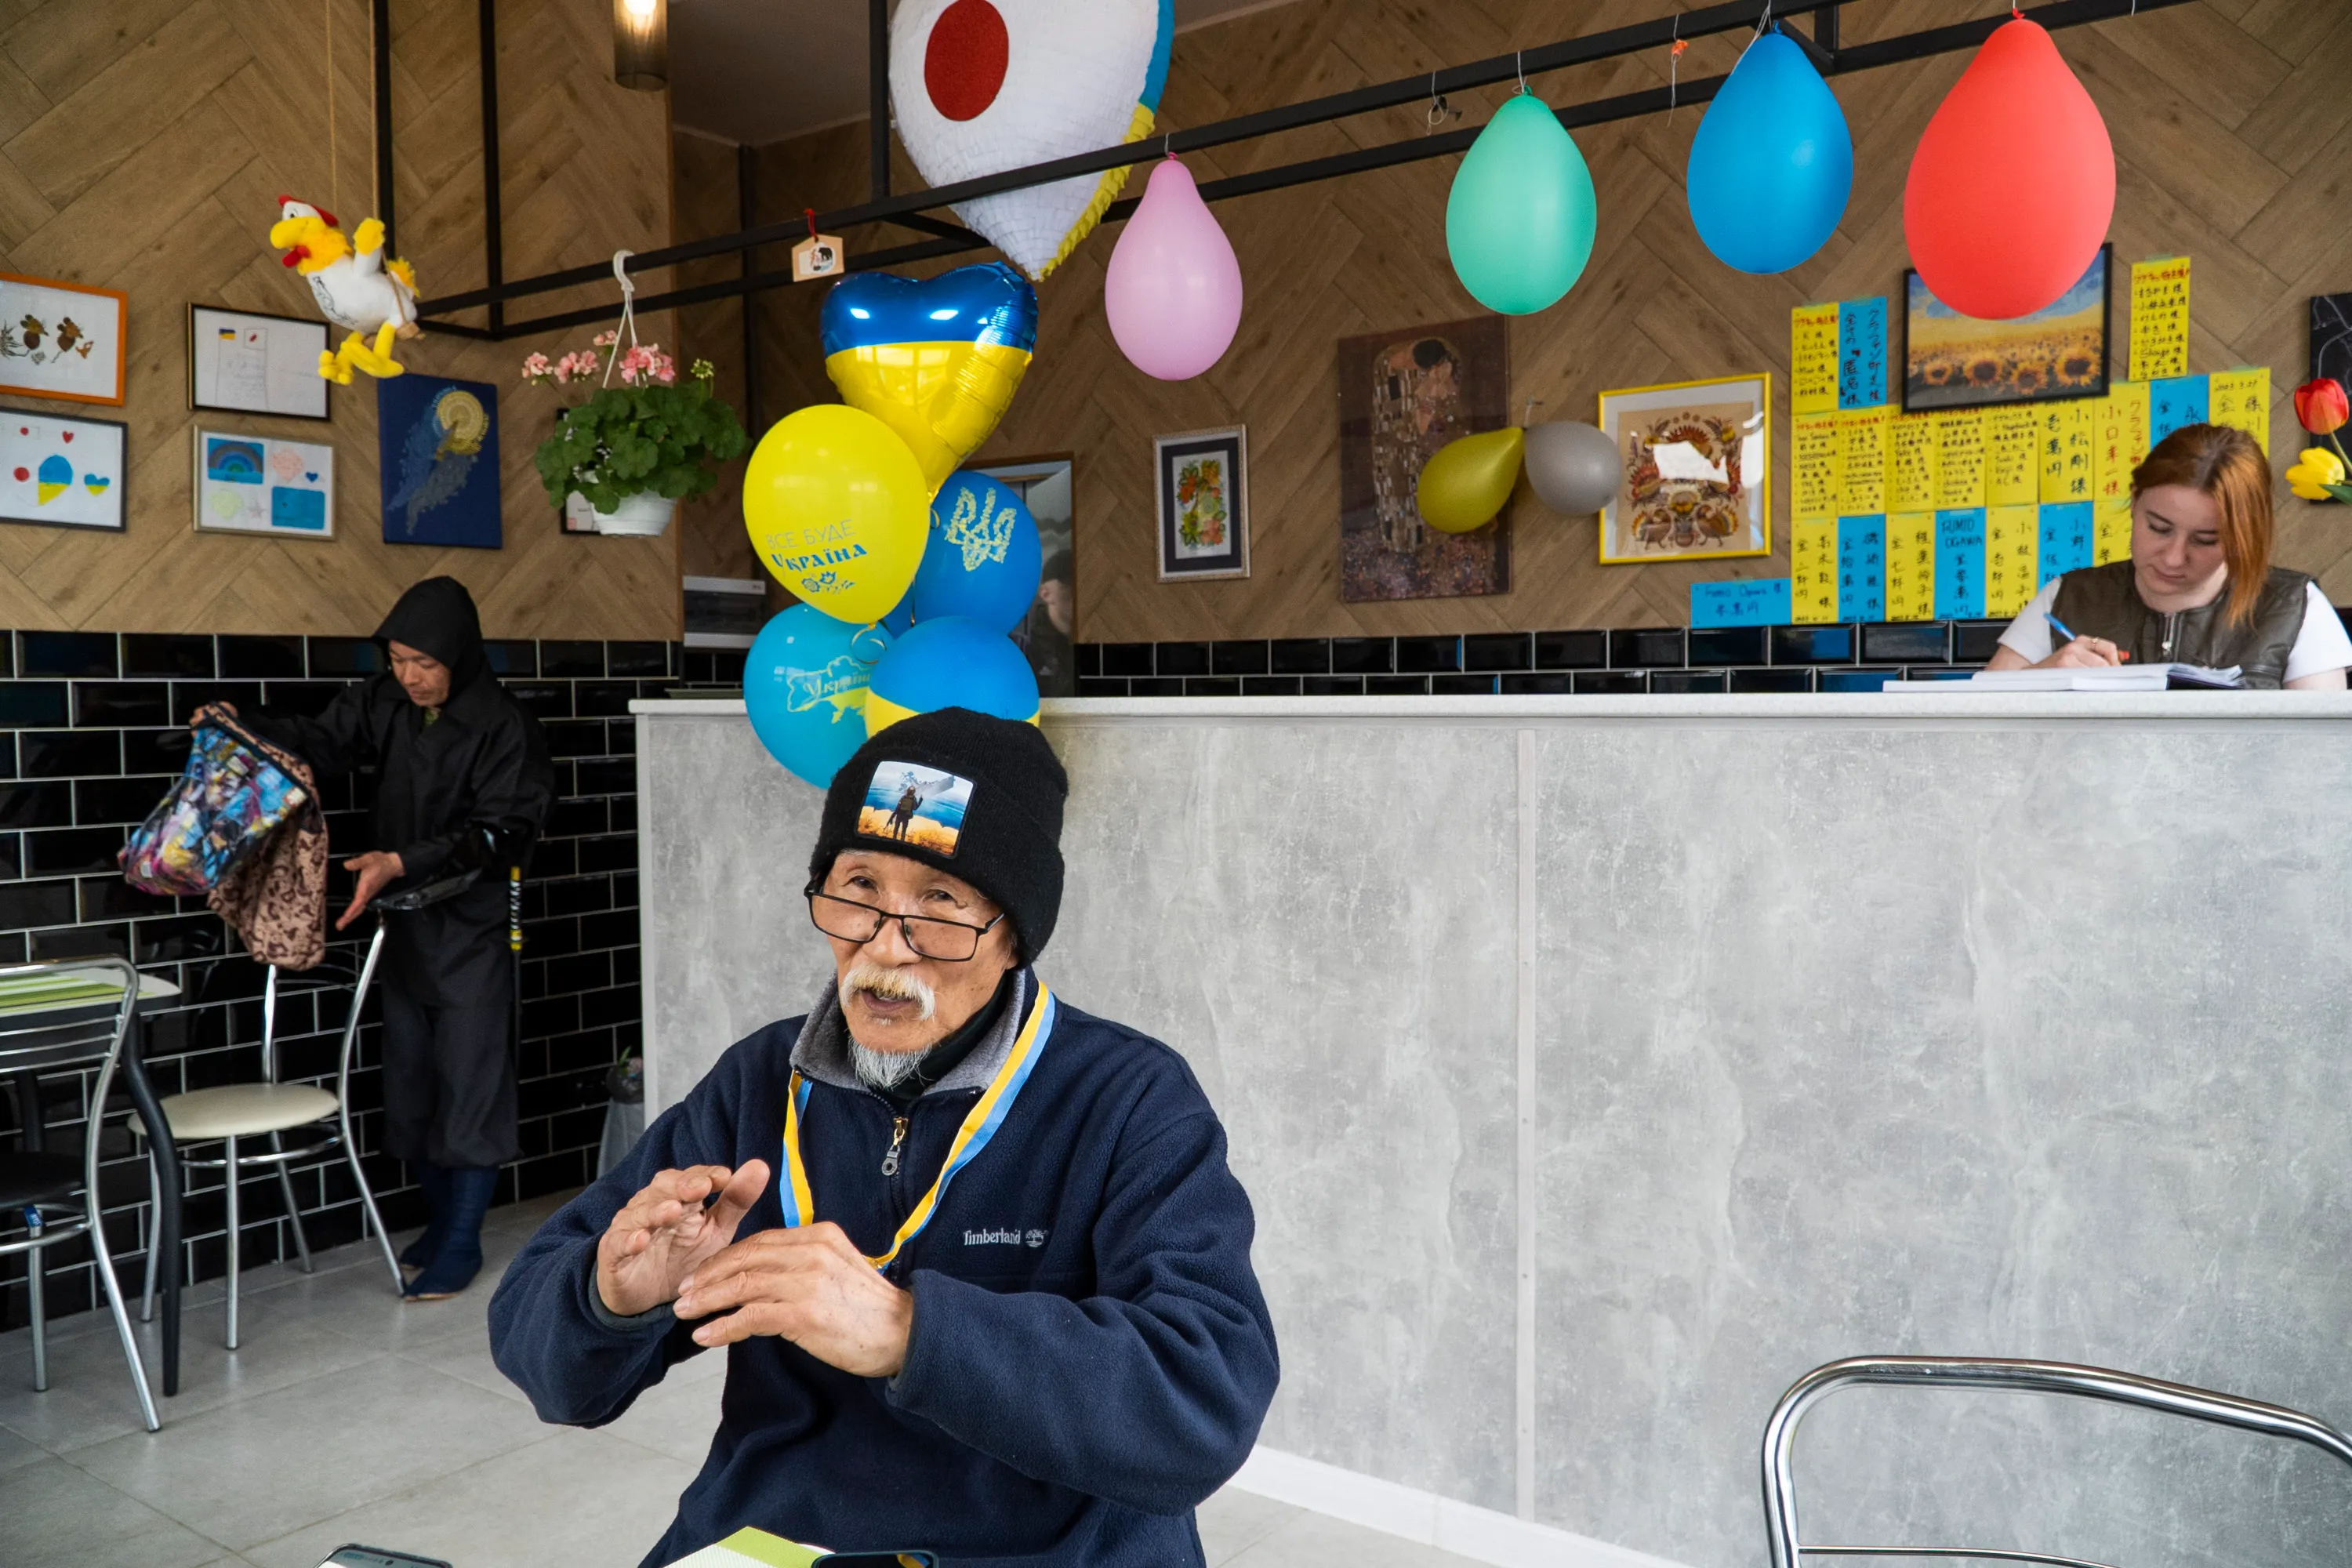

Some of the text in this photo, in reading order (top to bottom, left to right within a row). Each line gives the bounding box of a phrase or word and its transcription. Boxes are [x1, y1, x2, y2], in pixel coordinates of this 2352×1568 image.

[765, 518, 855, 550] ВСЕ БУДЕ
[963, 1227, 1022, 1246] Timberland
